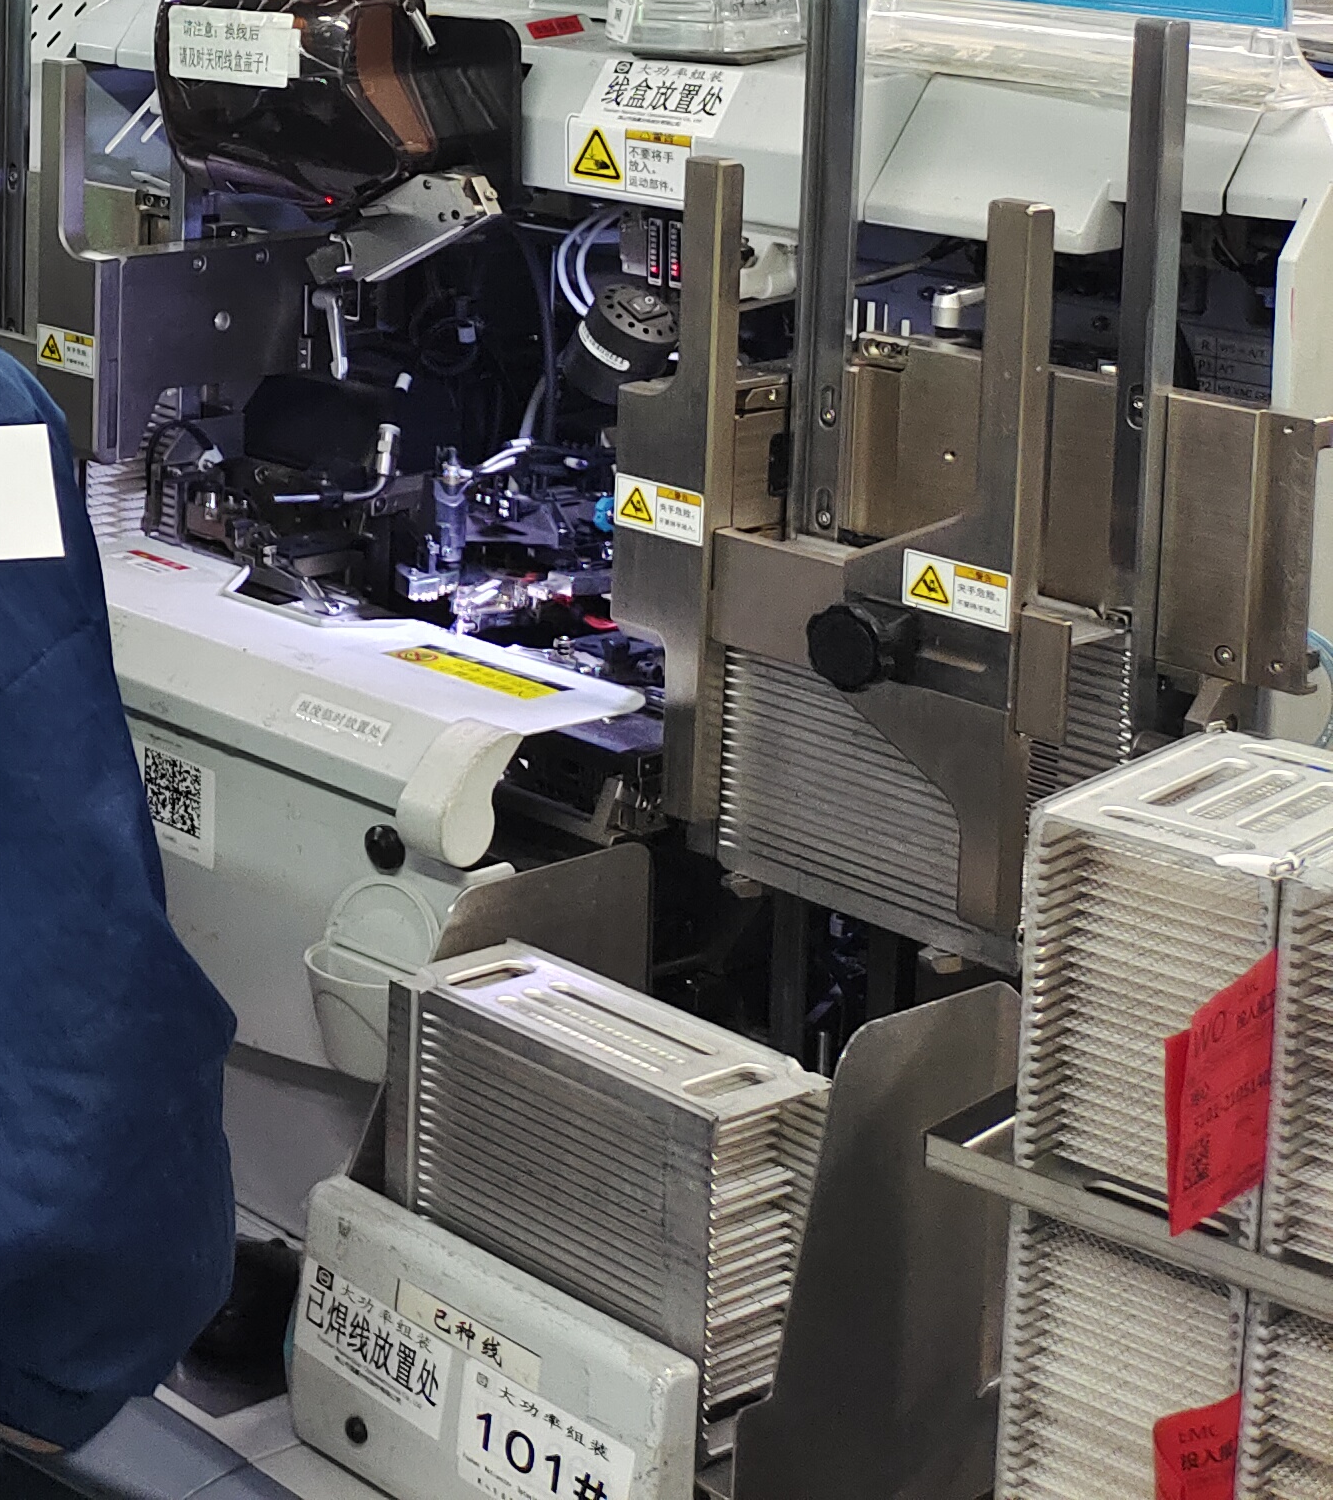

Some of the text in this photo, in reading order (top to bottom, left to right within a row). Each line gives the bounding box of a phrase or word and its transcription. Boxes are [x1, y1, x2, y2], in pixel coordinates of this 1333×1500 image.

[601, 75, 723, 117] 线盒放置处
[305, 1283, 441, 1408] 已焊线放置处
[476, 1412, 609, 1500] 101#
